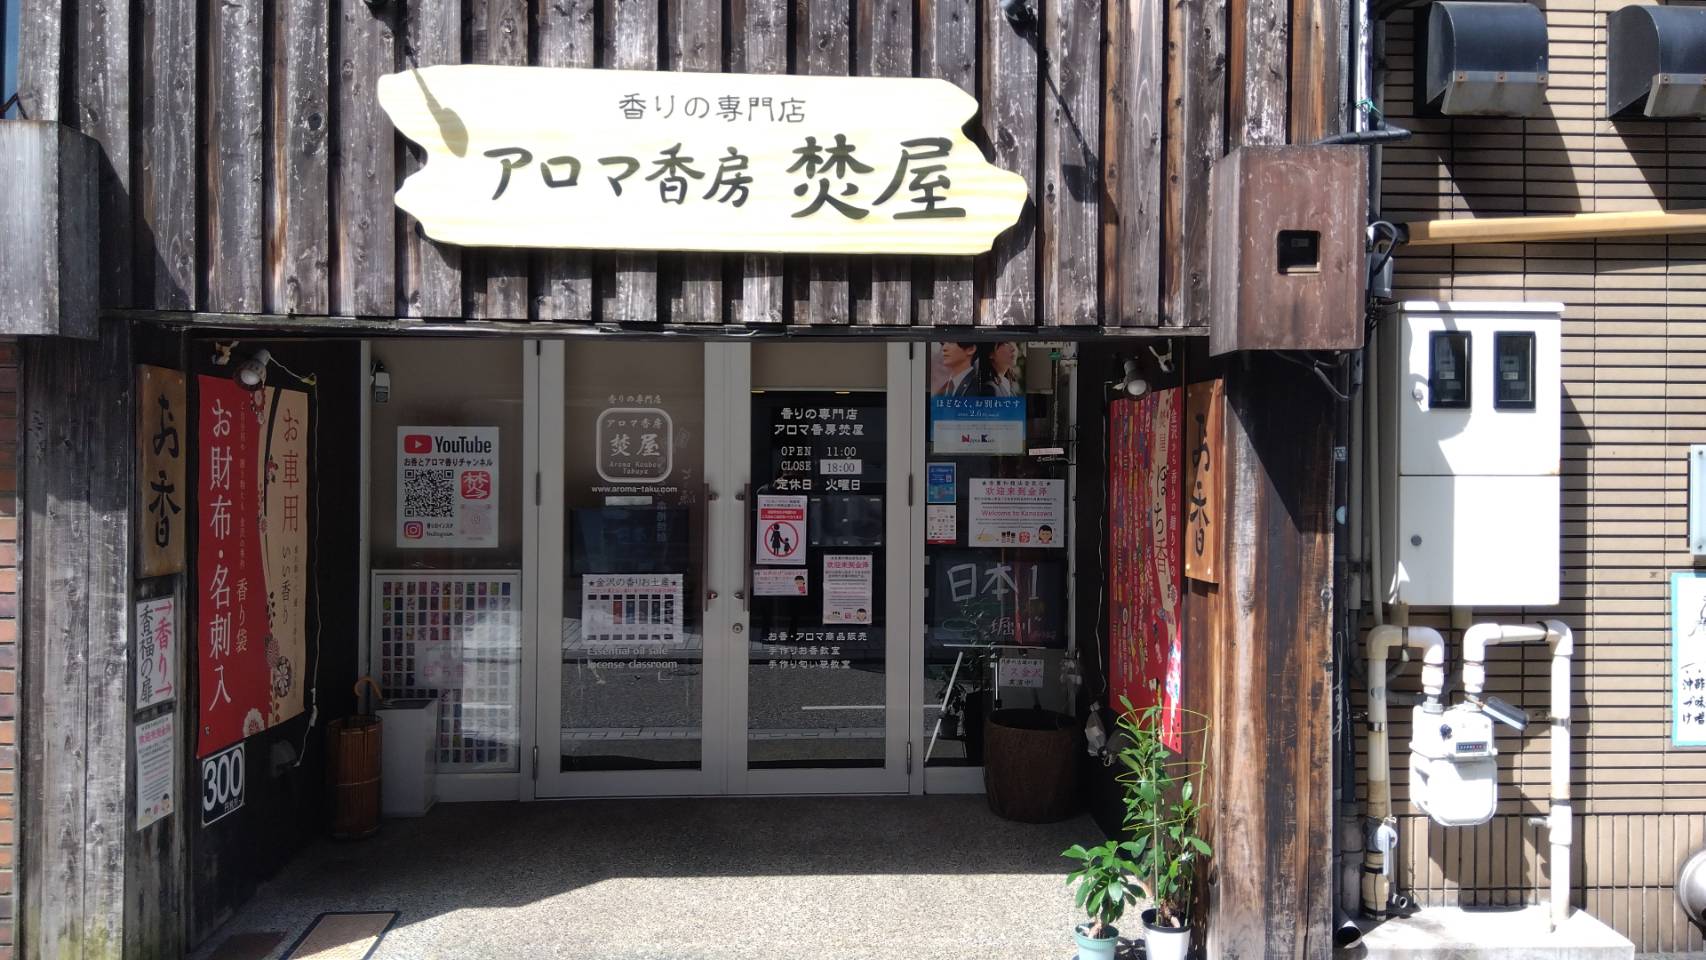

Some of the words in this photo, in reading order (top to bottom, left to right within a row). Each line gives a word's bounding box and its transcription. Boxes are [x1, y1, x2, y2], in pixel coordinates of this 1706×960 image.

[618, 92, 807, 123] 香りの専門店
[484, 142, 754, 207] アロマ香房
[785, 132, 967, 220] 焚屋
[936, 399, 1021, 409] ほどなく、お別れです
[781, 407, 859, 420] 香りの専門店
[774, 424, 865, 436] アロマ香房焚屋
[435, 435, 492, 454] YouTube
[610, 433, 661, 457] 焚屋
[781, 446, 813, 456] OPEN
[826, 446, 857, 457] 11:00
[282, 408, 299, 534] お車用
[781, 461, 813, 471] CLOSE
[827, 462, 855, 473] 18:00
[591, 485, 678, 494] www.aroma-taku.com
[776, 478, 812, 491] 定休日
[825, 478, 861, 491] 火曜日
[209, 397, 234, 712] お財布・名刺入
[236, 577, 249, 655] 香り袋
[768, 631, 868, 642] お香・アロマ商品販売
[154, 616, 172, 684] 香り
[633, 647, 645, 656] oil
[628, 660, 678, 669] classroom
[203, 749, 243, 812] 300
